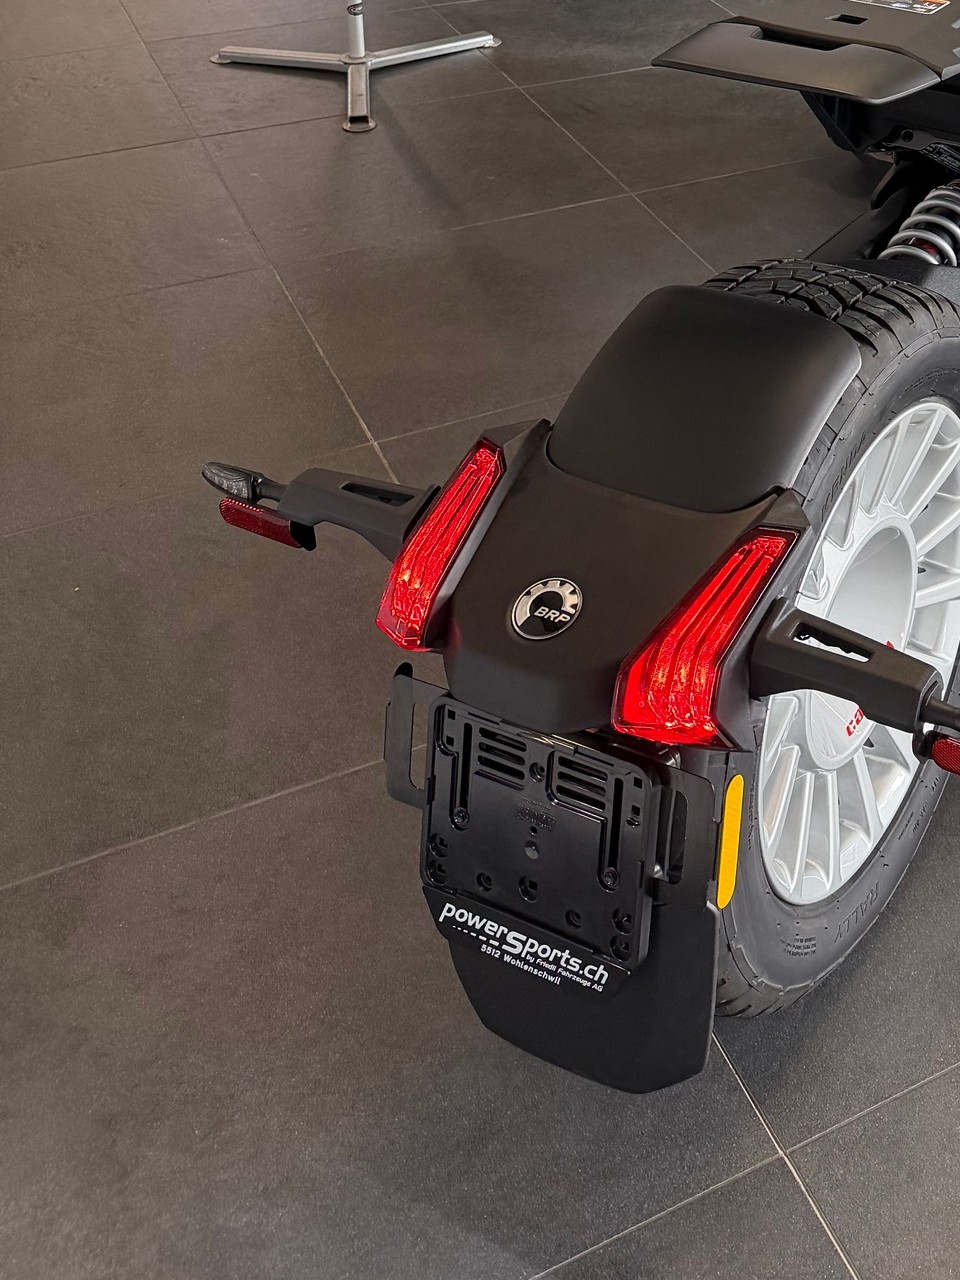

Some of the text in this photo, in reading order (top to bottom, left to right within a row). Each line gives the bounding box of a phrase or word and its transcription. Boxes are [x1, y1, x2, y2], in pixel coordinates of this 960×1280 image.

[533, 606, 571, 623] BRP
[480, 943, 561, 986] 5512 Wohlenschwil
[525, 953, 604, 992] by Friedli Fahrzeuge AG
